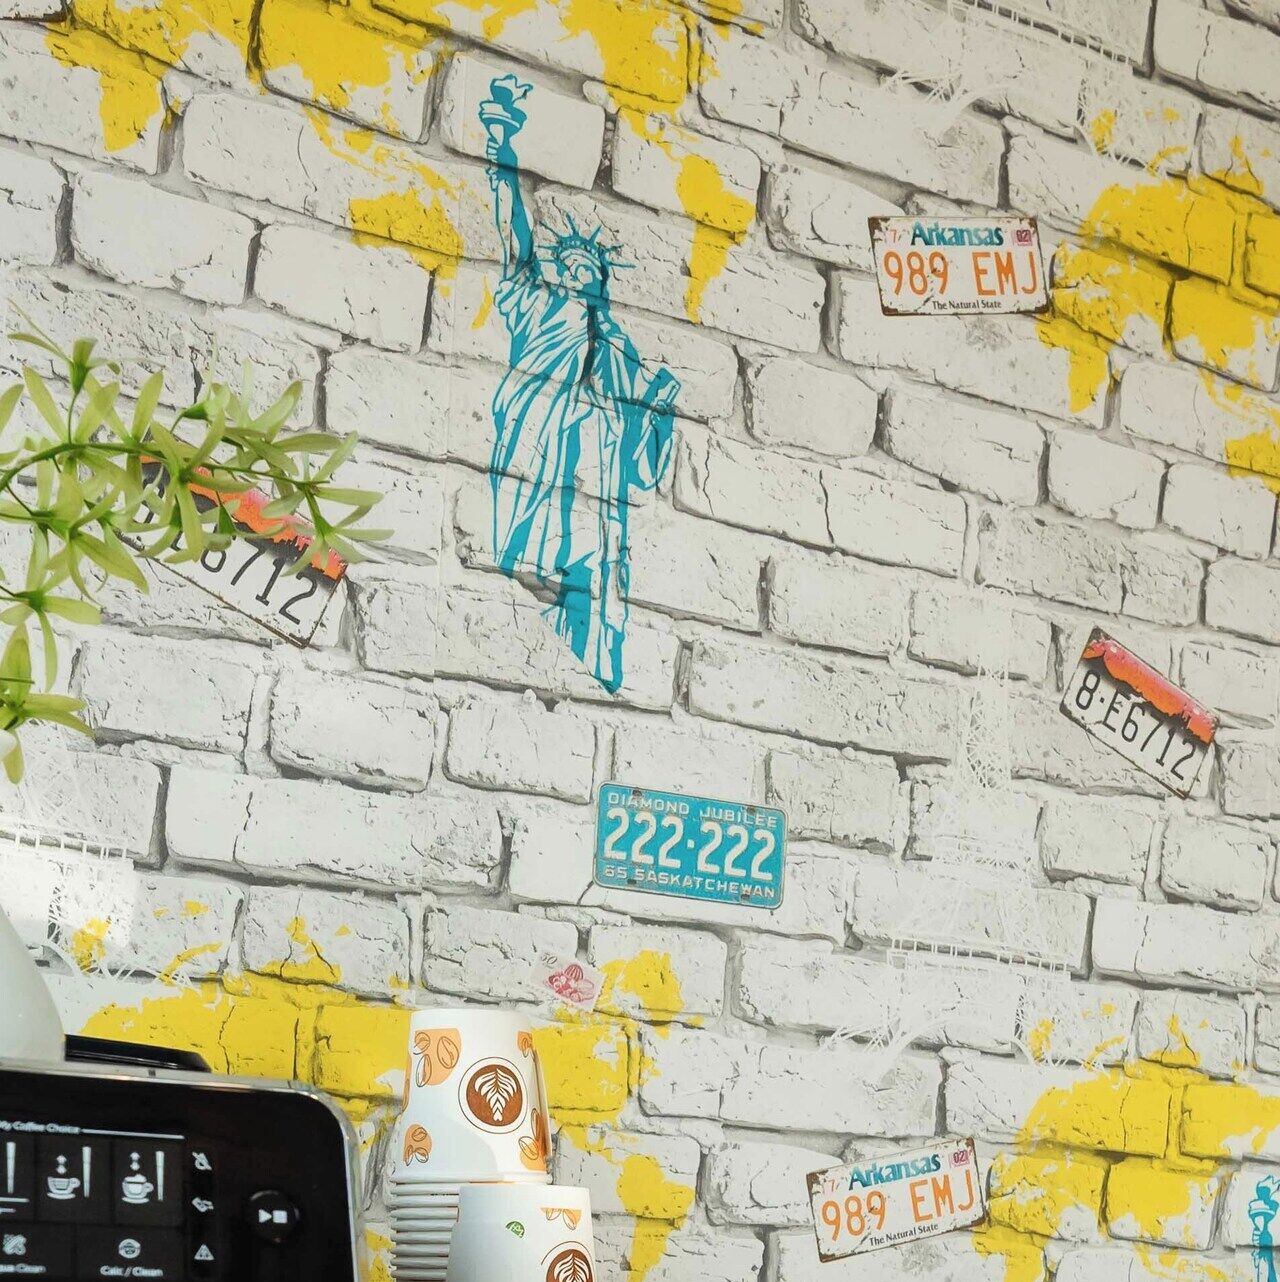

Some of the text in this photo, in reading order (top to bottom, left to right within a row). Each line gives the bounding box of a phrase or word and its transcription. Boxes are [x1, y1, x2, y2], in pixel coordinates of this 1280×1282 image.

[910, 220, 1004, 247] Arkansas
[883, 250, 1038, 296] 989 EMJ
[932, 299, 1002, 311] The Natural State
[607, 792, 778, 829] DIAMOND JUBILEE
[634, 866, 775, 898] SASKATCHEWAN
[848, 1153, 942, 1191] Arkansas
[821, 1169, 975, 1242] 989 EMJ
[870, 1222, 939, 1246] The Natural State
